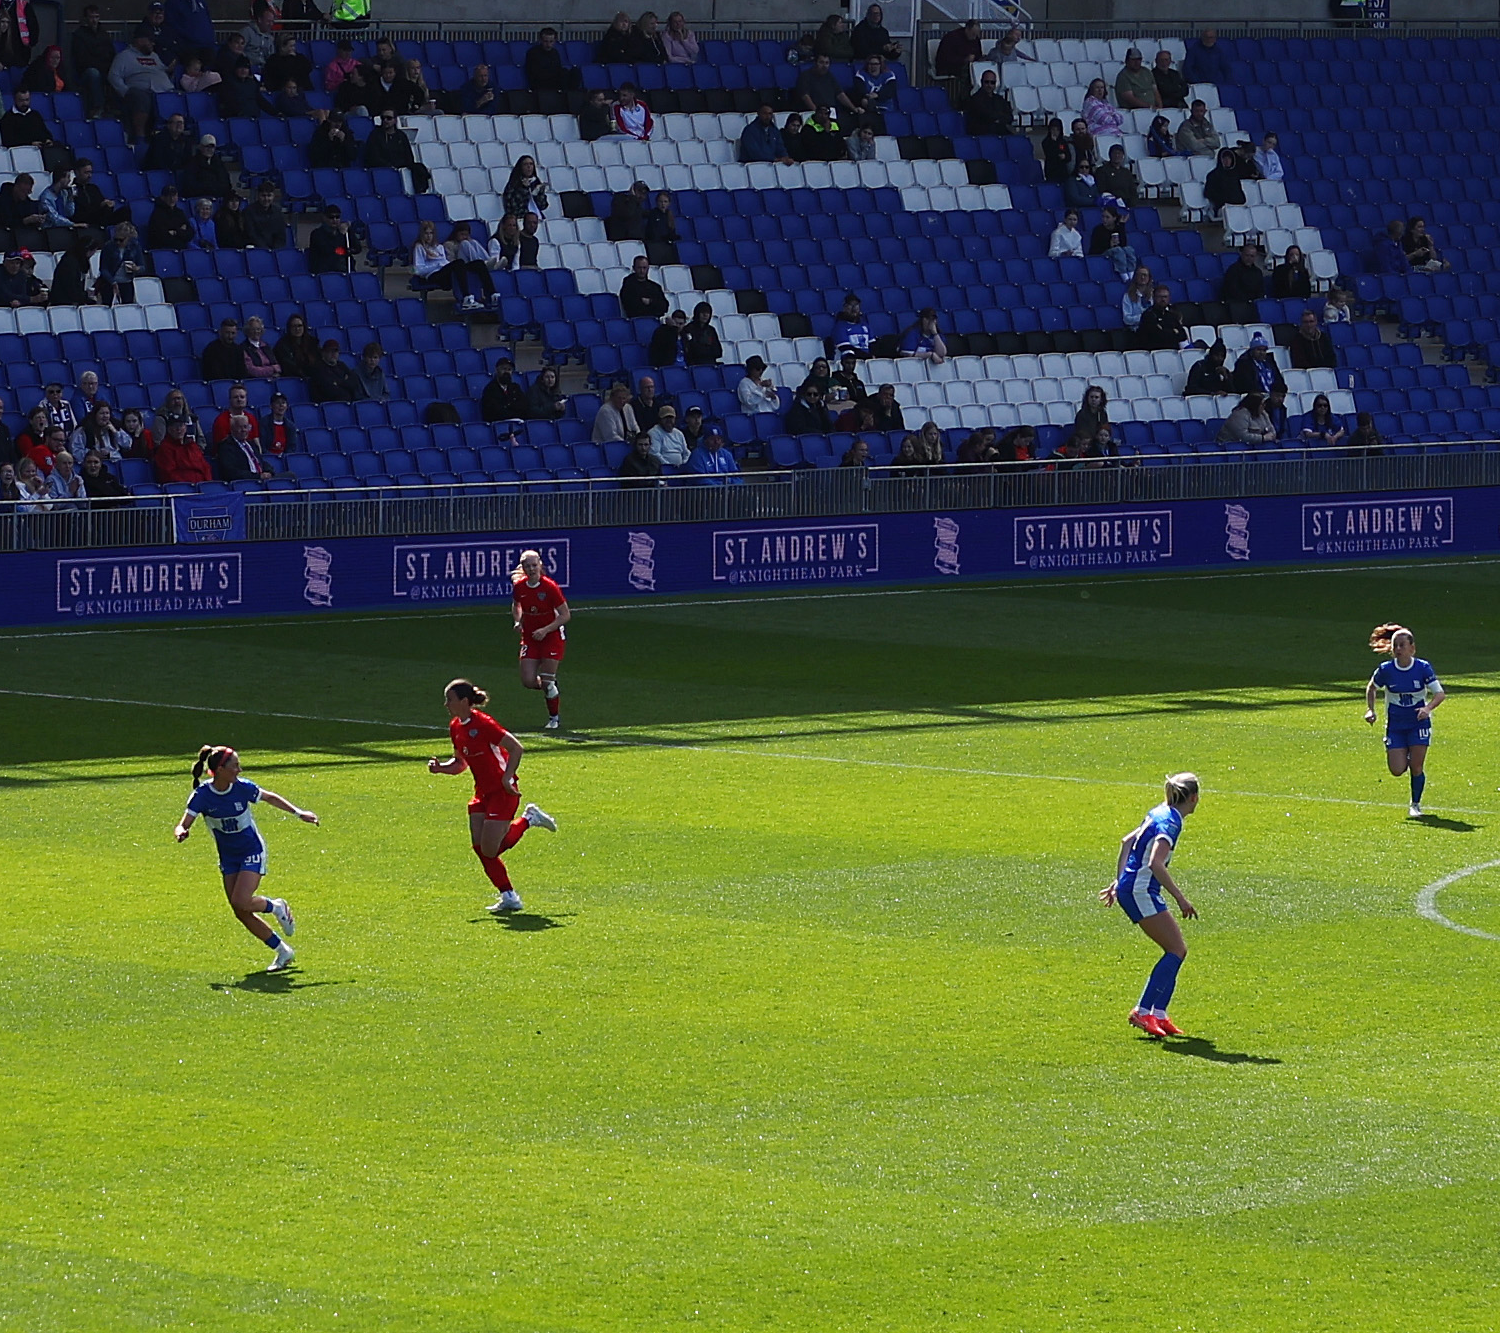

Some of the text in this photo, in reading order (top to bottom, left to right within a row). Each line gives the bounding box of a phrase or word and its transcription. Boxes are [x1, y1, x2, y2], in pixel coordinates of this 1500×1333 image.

[189, 516, 231, 530] DURHAM
[1409, 535, 1439, 548] PARK
[1125, 549, 1157, 563] PARK
[830, 564, 863, 578] PARK
[188, 594, 224, 611] PARK
